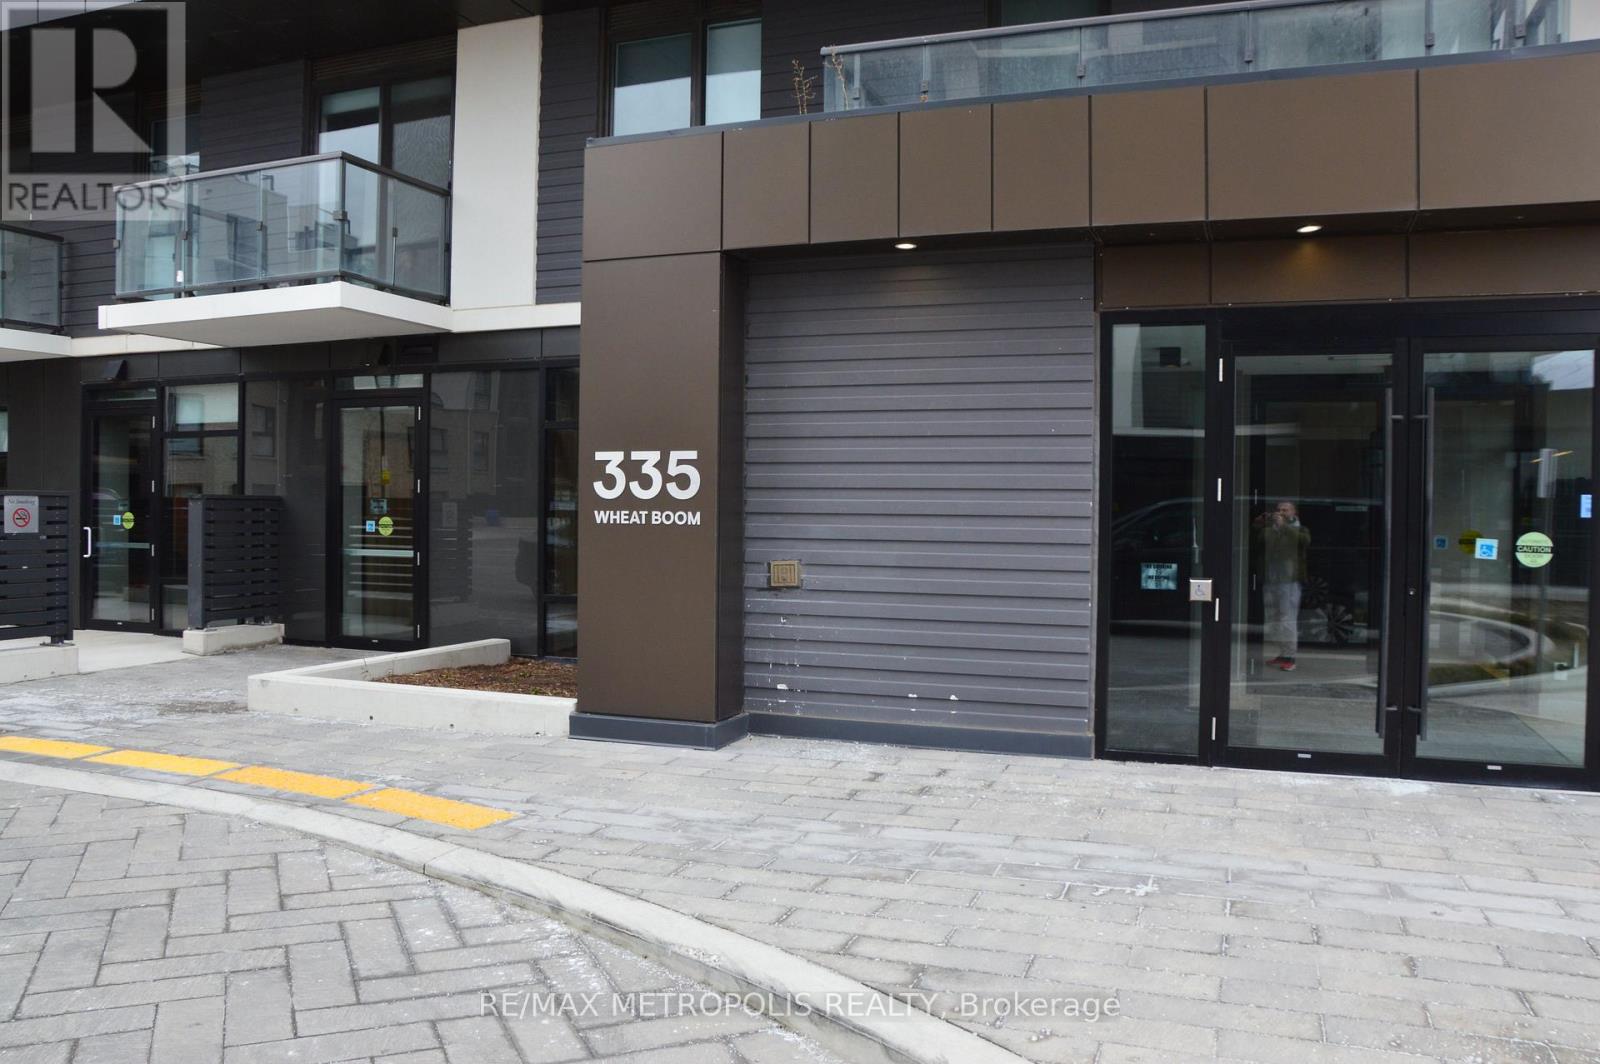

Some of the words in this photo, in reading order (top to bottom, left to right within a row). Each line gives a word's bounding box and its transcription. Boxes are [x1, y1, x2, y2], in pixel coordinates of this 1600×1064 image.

[593, 450, 701, 500] 335
[594, 510, 648, 525] WHEAT
[651, 511, 701, 526] BOOM
[1517, 545, 1552, 553] CAUTION
